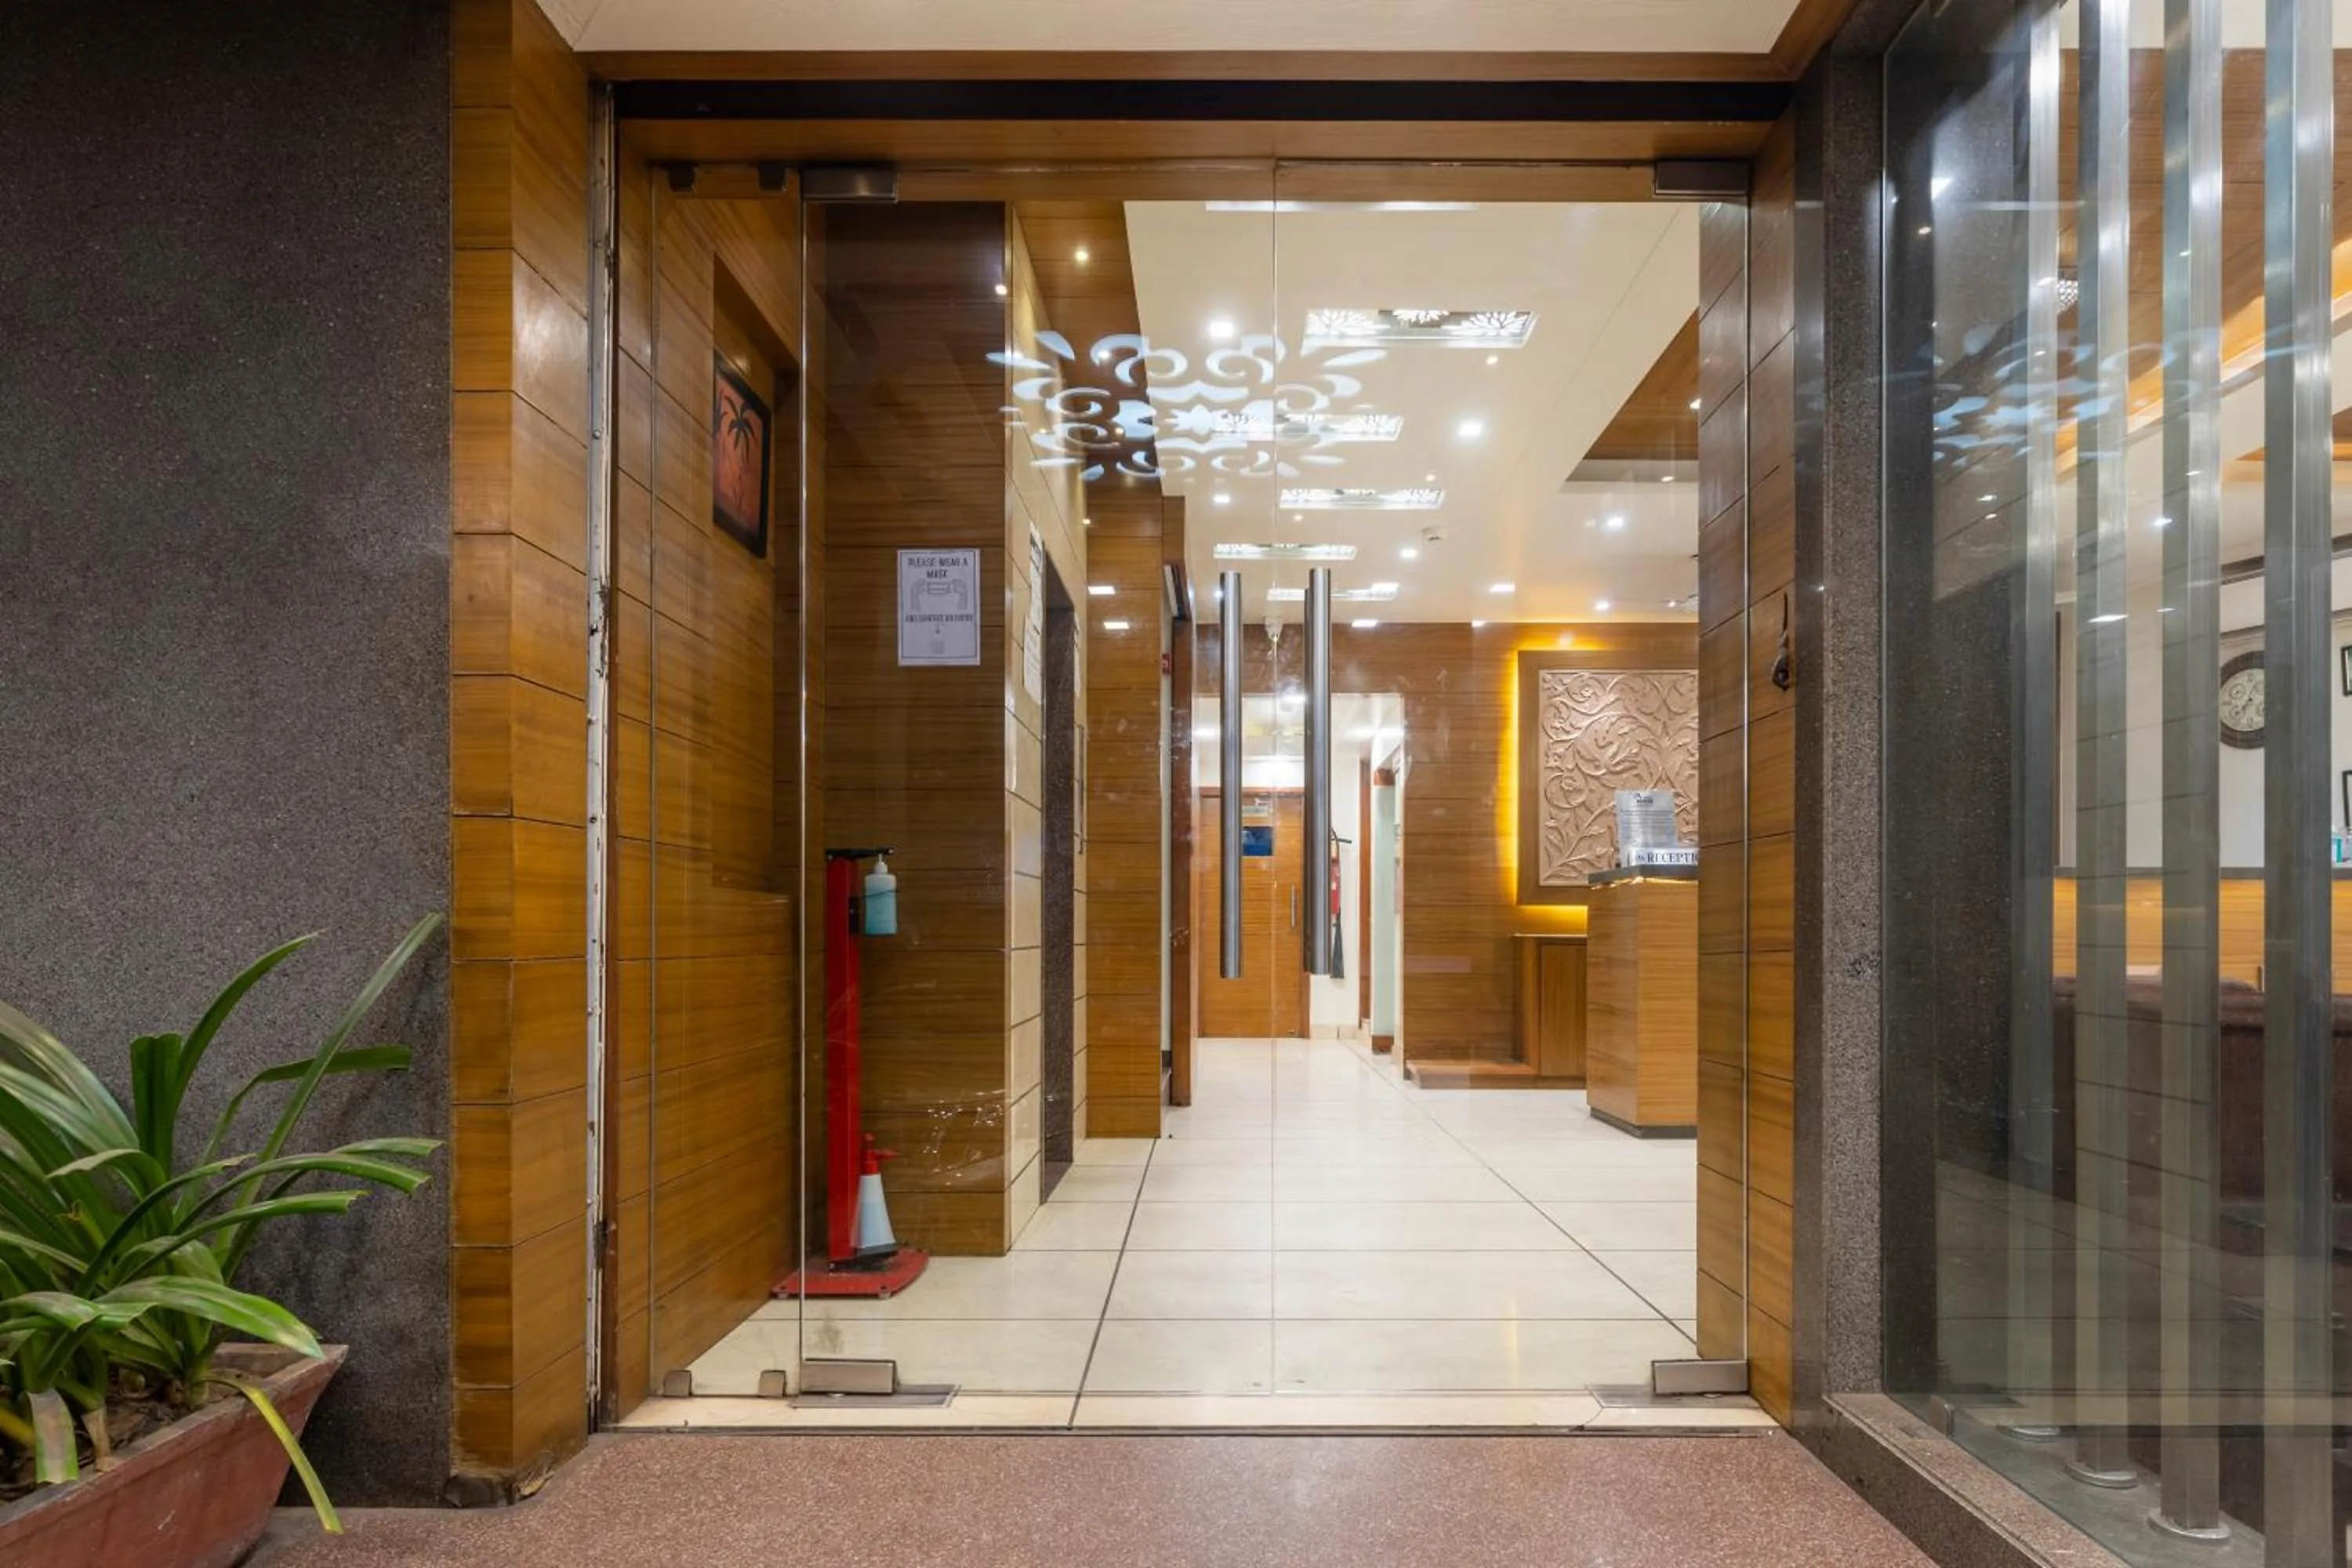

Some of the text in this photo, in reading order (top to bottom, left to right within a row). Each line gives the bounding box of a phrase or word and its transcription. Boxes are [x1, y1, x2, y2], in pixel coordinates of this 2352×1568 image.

[907, 557, 968, 568] PLEASE WEAR A
[926, 570, 948, 579] MASK
